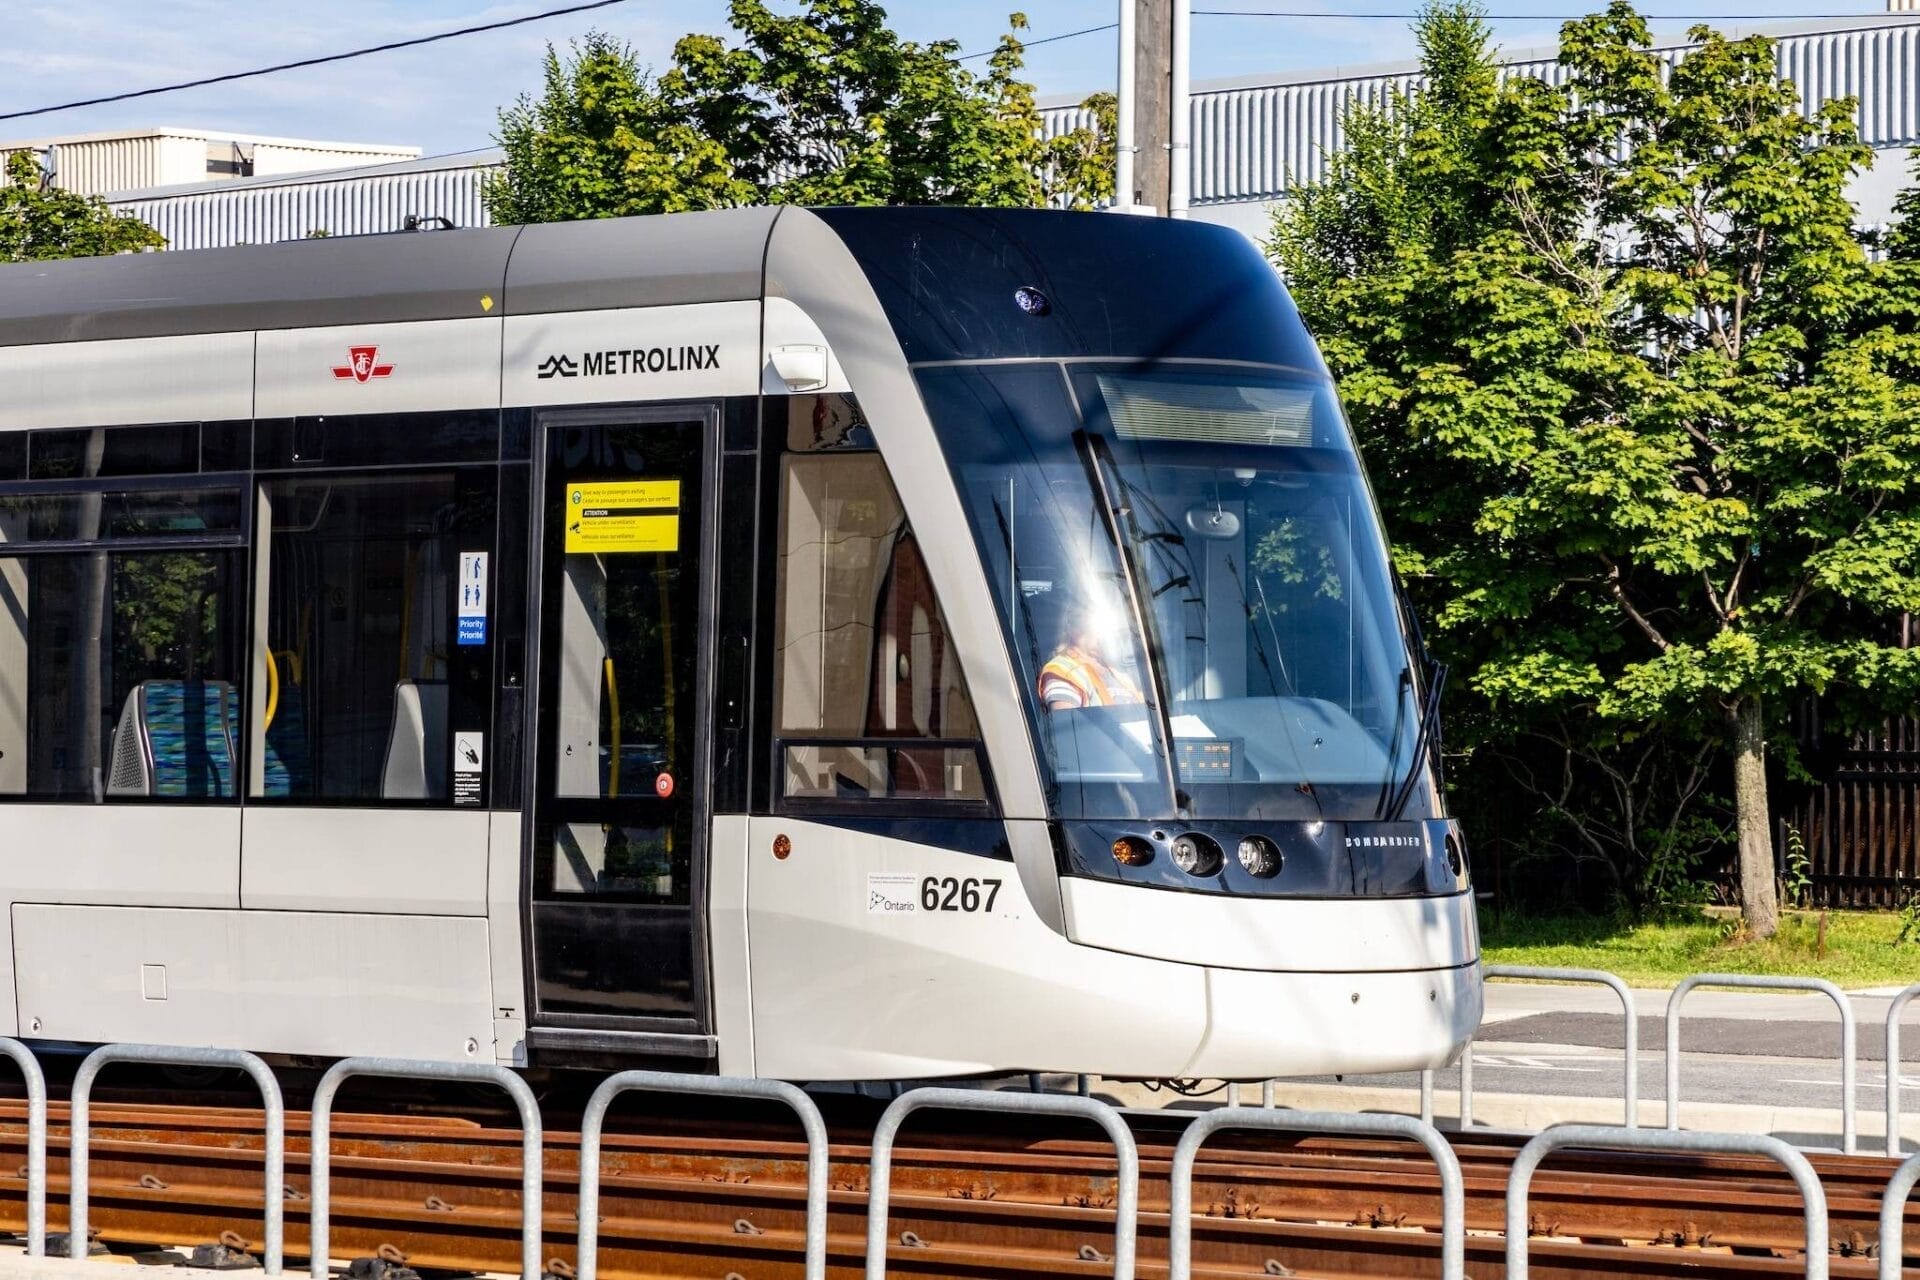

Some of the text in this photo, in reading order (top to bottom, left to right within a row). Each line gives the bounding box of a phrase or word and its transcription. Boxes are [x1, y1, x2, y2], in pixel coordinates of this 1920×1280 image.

[583, 344, 720, 377] METROLINX
[460, 620, 483, 630] Priority
[1345, 836, 1420, 848] BOMBARDIER
[921, 876, 1002, 913] 6267
[884, 899, 915, 912] Ontario
